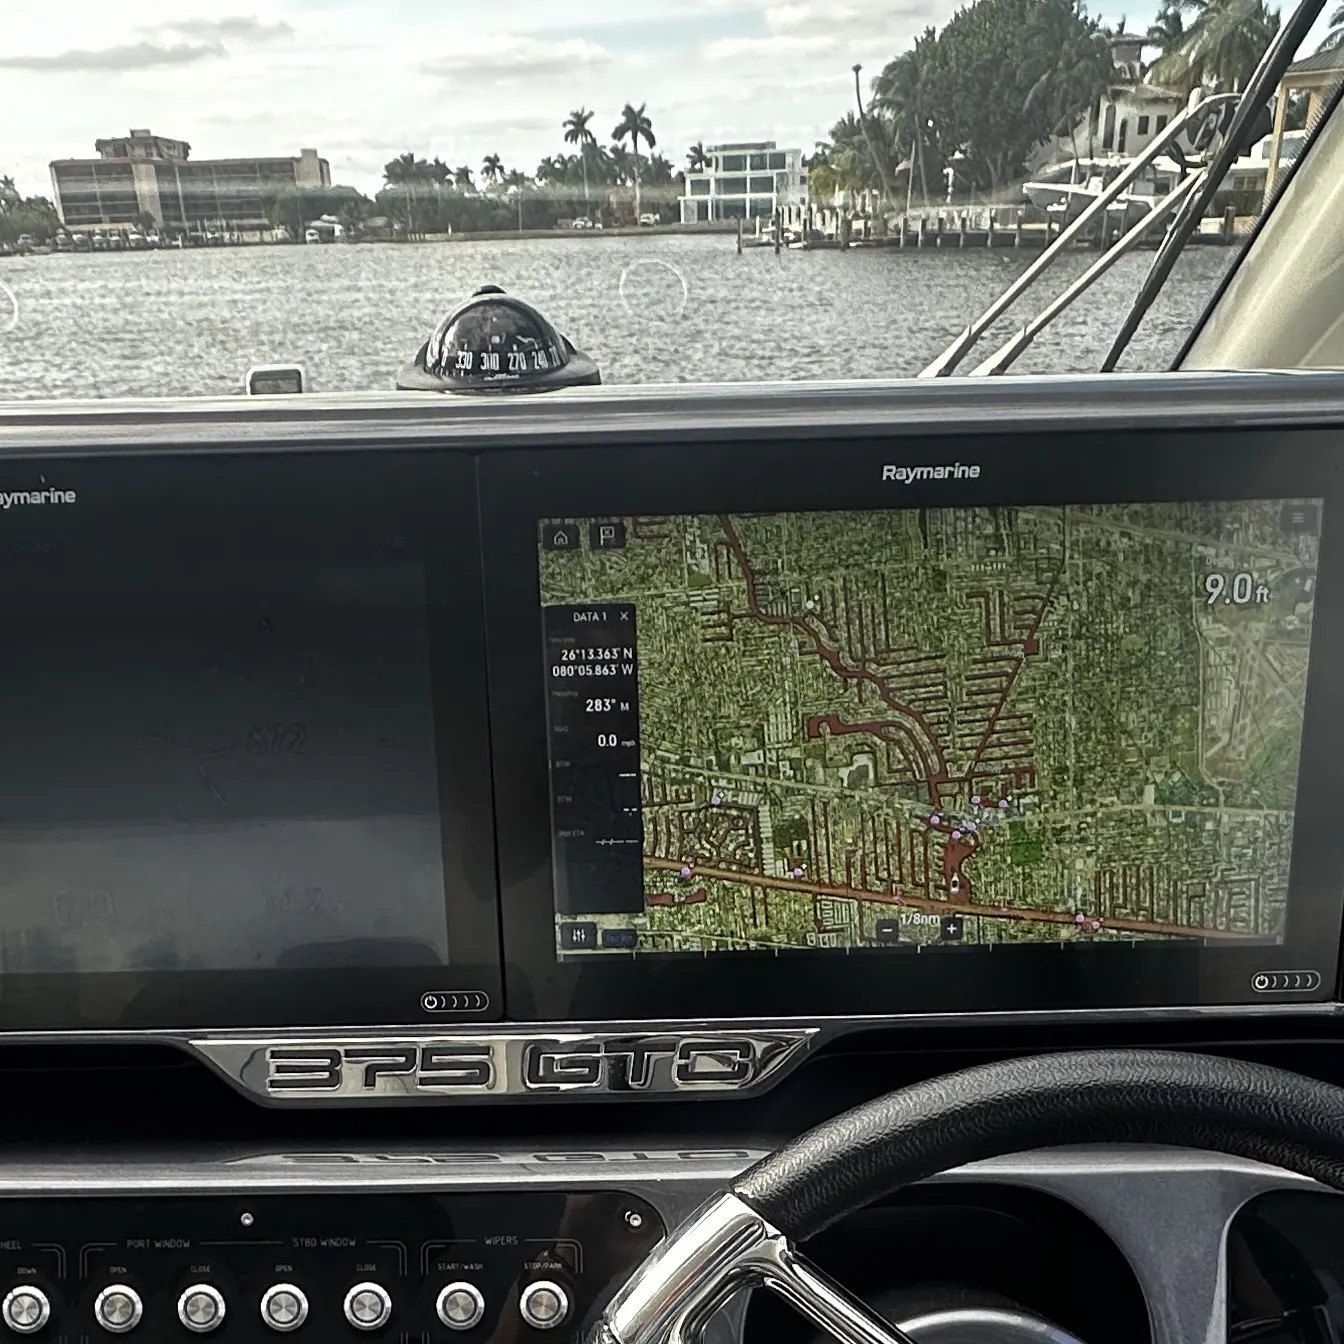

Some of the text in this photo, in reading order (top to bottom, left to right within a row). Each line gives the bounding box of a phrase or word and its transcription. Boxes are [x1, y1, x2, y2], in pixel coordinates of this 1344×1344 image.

[507, 352, 527, 371] 270
[881, 461, 981, 485] Raymarine
[1205, 572, 1271, 605] 9.0 ft
[572, 611, 608, 623] DATA 1
[623, 647, 634, 660] N
[621, 663, 634, 676] W
[596, 733, 618, 748] 0.0
[265, 1039, 755, 1093] 375 GTO
[126, 1238, 190, 1248] PORT WINDOW
[292, 1237, 357, 1248] STBD WINDOW
[484, 1236, 518, 1246] WIPERS
[17, 1266, 37, 1275] DOWN
[109, 1265, 127, 1274] OPEN
[190, 1264, 211, 1273] CLOSE
[275, 1264, 293, 1272] OPEN
[356, 1263, 377, 1272] CLOSE
[524, 1261, 563, 1270] STOP/PARK
